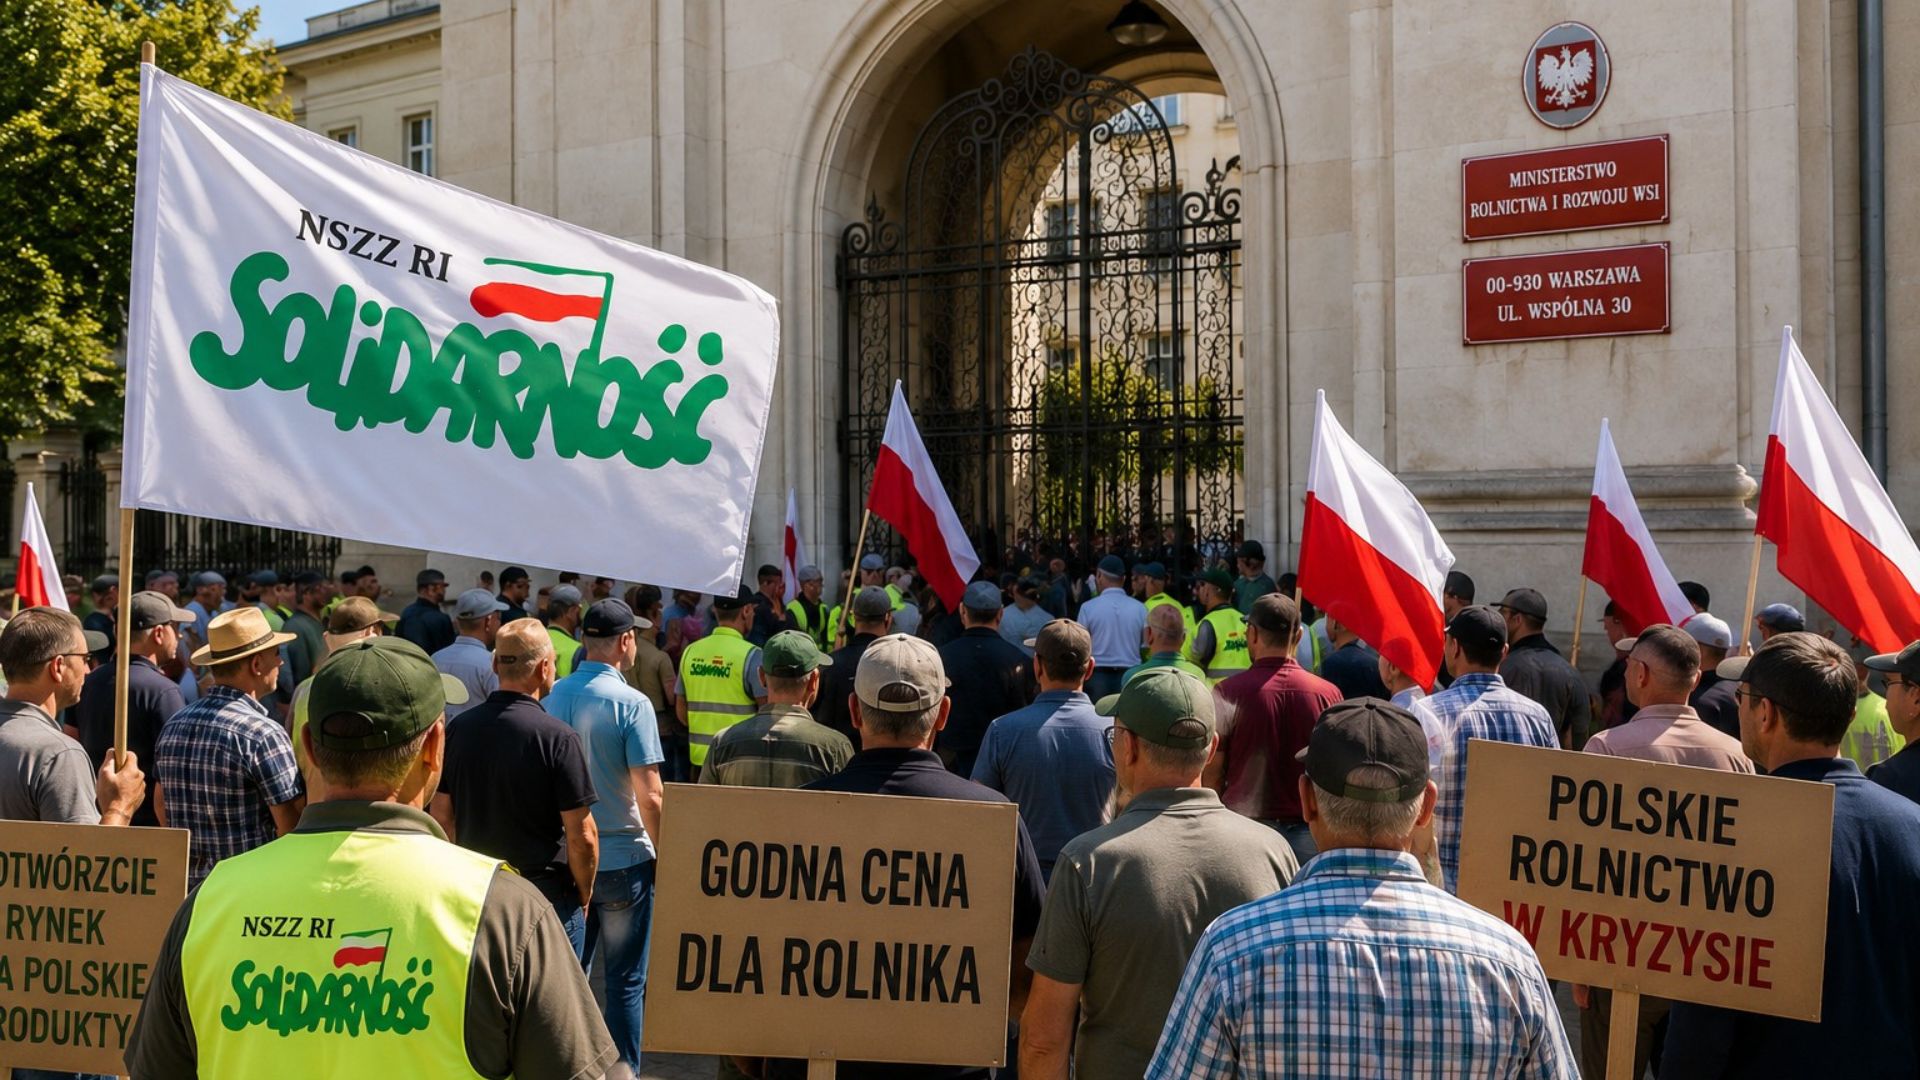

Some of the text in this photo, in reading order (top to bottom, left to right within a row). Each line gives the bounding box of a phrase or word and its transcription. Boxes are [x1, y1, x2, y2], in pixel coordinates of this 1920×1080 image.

[1509, 161, 1617, 188] MINISTERSTWO
[1470, 184, 1660, 218] ROLNICTWA I ROZWOJU WSI
[296, 209, 453, 283] NSZZ RI
[1486, 266, 1641, 294] 00-930 WARSZAWA
[1498, 296, 1632, 322] UL. WSPÓLNA 30
[1548, 774, 1739, 847] POLSKIE
[700, 839, 970, 909] GODNA CENA
[1509, 834, 1775, 918] ROLNICTWO
[6, 903, 106, 946] RYNEK
[241, 916, 335, 939] NSZZ RI
[1503, 900, 1775, 990] W KRYZYSIE
[24, 956, 148, 1000] POLSKIE
[676, 933, 981, 1005] DLA ROLNIKA
